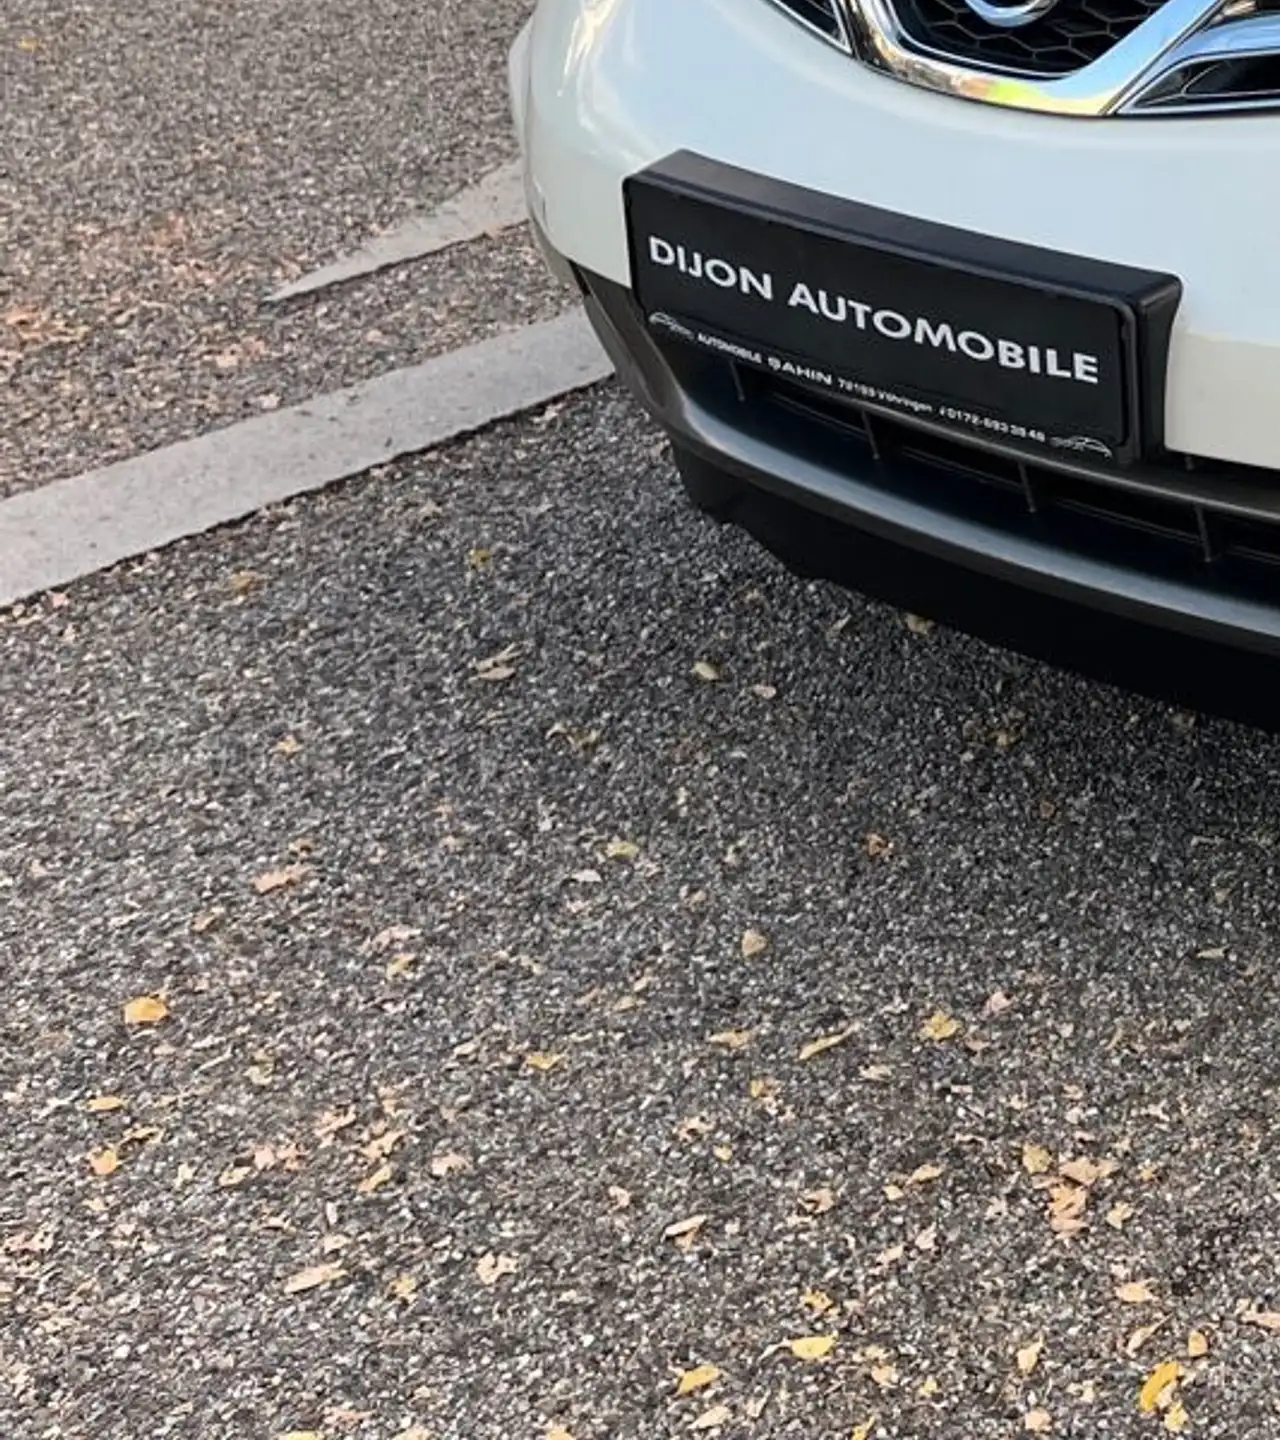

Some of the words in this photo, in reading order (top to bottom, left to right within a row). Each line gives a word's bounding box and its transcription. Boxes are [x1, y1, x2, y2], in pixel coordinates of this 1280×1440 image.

[648, 235, 773, 300] DIJON
[788, 282, 1099, 384] AUTOMOBILE
[698, 332, 762, 364] AUTOMOBILE
